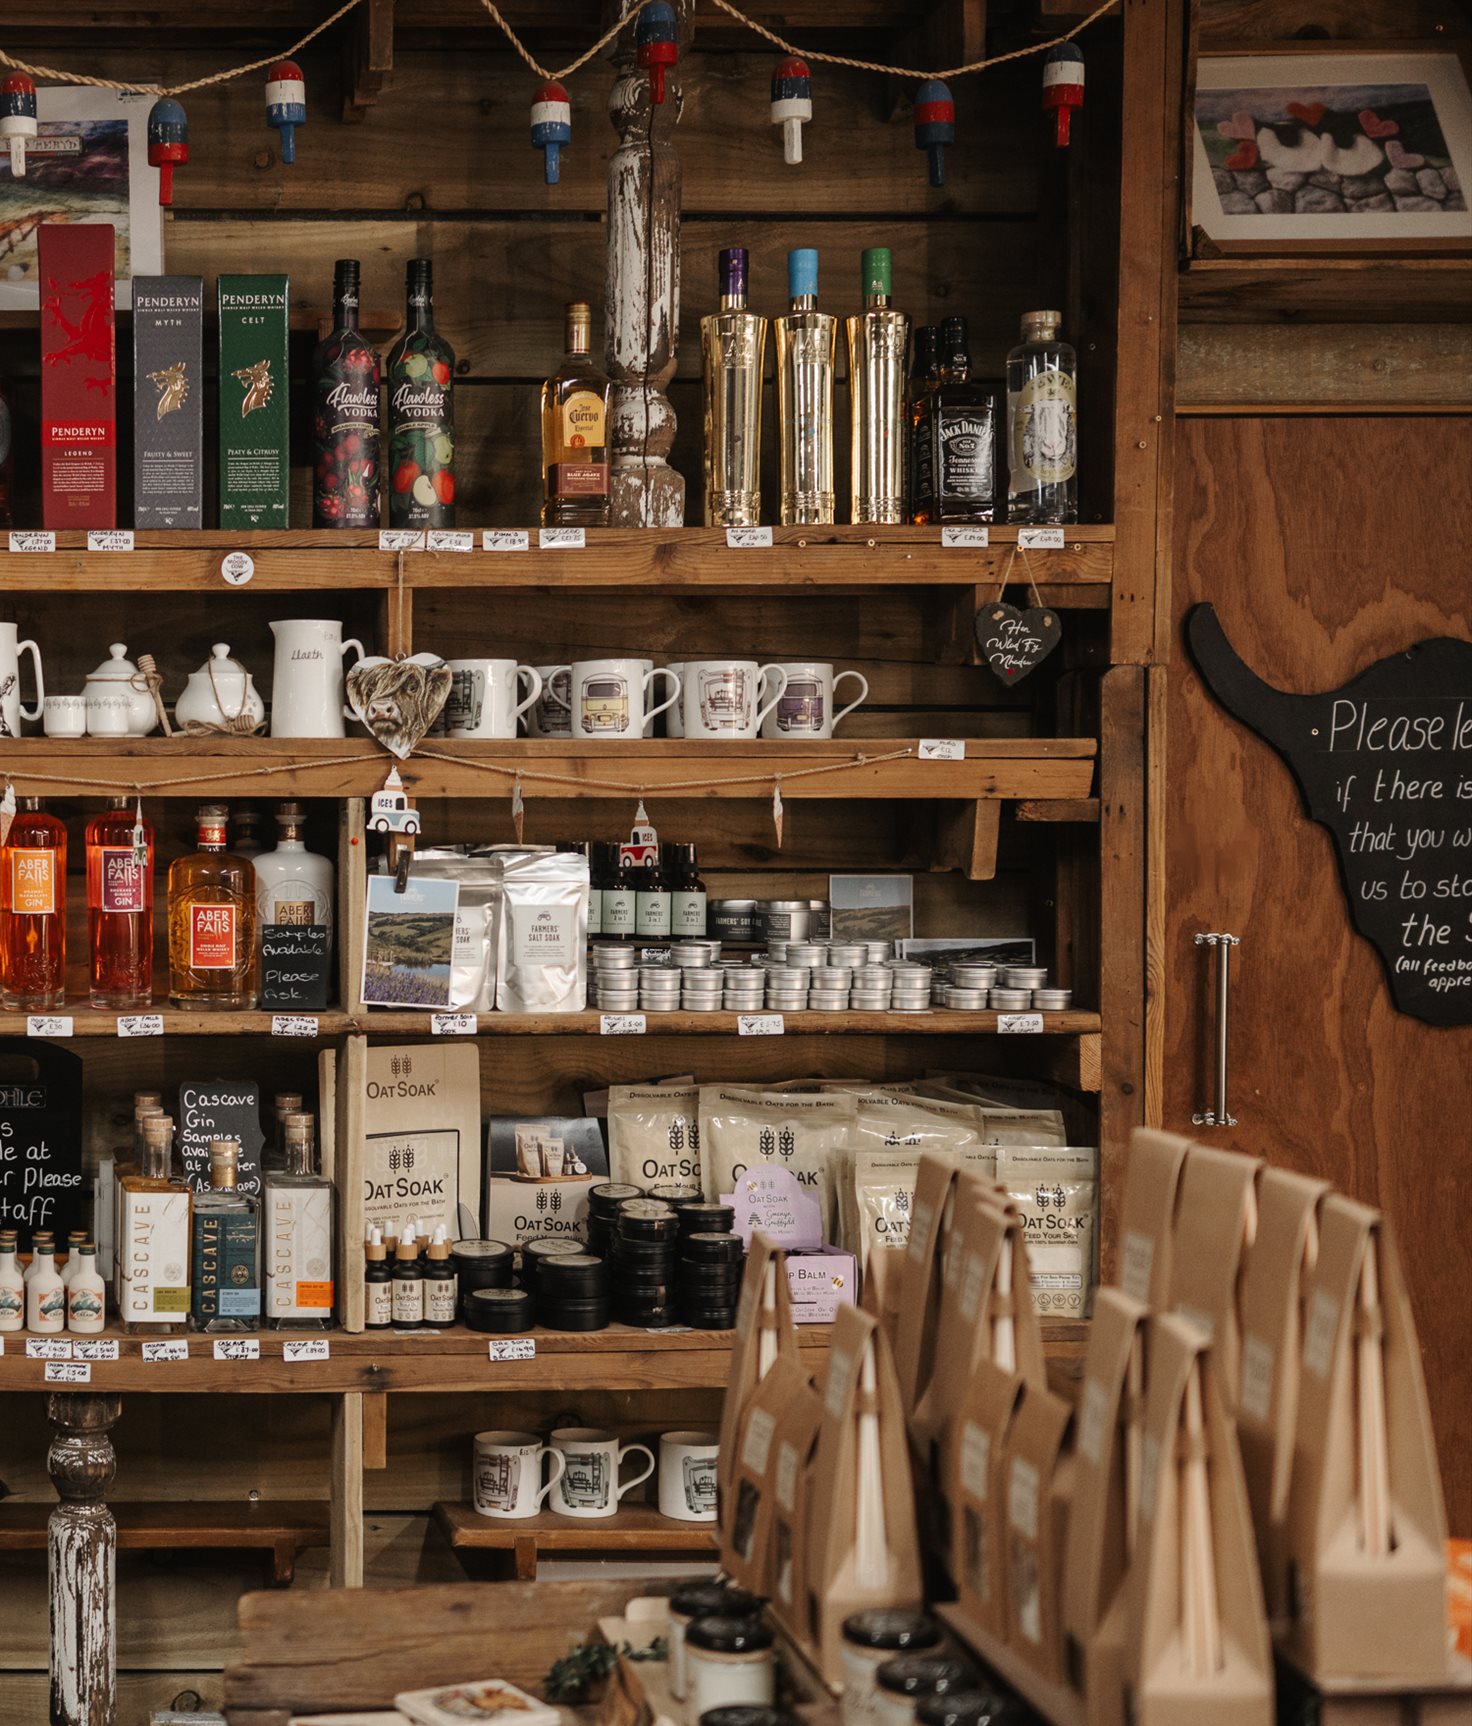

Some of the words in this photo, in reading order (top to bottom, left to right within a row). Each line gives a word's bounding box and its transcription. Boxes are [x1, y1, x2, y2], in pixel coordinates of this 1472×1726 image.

[137, 297, 199, 307] PENDERYN
[222, 295, 285, 305] PENDERYN
[326, 382, 378, 406] Flawless
[392, 382, 444, 406] Flawless
[344, 408, 378, 418] VODKA
[406, 408, 444, 417] VODKA
[569, 410, 598, 424] Cuervo
[52, 427, 105, 437] PENDERYN
[940, 423, 960, 442] JACK
[1000, 620, 1031, 635] Hen
[986, 634, 1022, 652] Wlad
[1021, 638, 1043, 654] Fy
[291, 649, 325, 660] Llaeth
[1330, 699, 1445, 752] Please
[1336, 774, 1356, 813] if
[1374, 769, 1444, 803] there
[378, 798, 393, 808] ICES
[1349, 821, 1397, 853] that
[1396, 827, 1445, 861] you
[18, 860, 48, 869] ABER
[1361, 881, 1389, 901] us
[1400, 870, 1426, 899] to
[25, 899, 43, 907] GIN
[115, 897, 133, 906] GIN
[196, 910, 229, 921] ABER
[279, 905, 310, 916] ABER
[264, 929, 326, 942] Samples
[532, 925, 561, 933] FARMERS'
[1401, 912, 1452, 947] the
[529, 934, 544, 942] SALT
[545, 933, 560, 942] SOAK
[263, 943, 324, 956] Available
[1395, 955, 1421, 973] (All
[265, 970, 320, 982] Please
[184, 1090, 255, 1108] Cascave
[186, 1110, 215, 1128] Gin
[182, 1129, 242, 1144] Samples
[26, 1141, 51, 1160] at
[185, 1160, 202, 1171] at
[133, 1205, 150, 1311] CASCAVE
[276, 1201, 292, 1307] CASCAVE
[202, 1219, 219, 1314] CASCAVE
[798, 1269, 826, 1280] BALM
